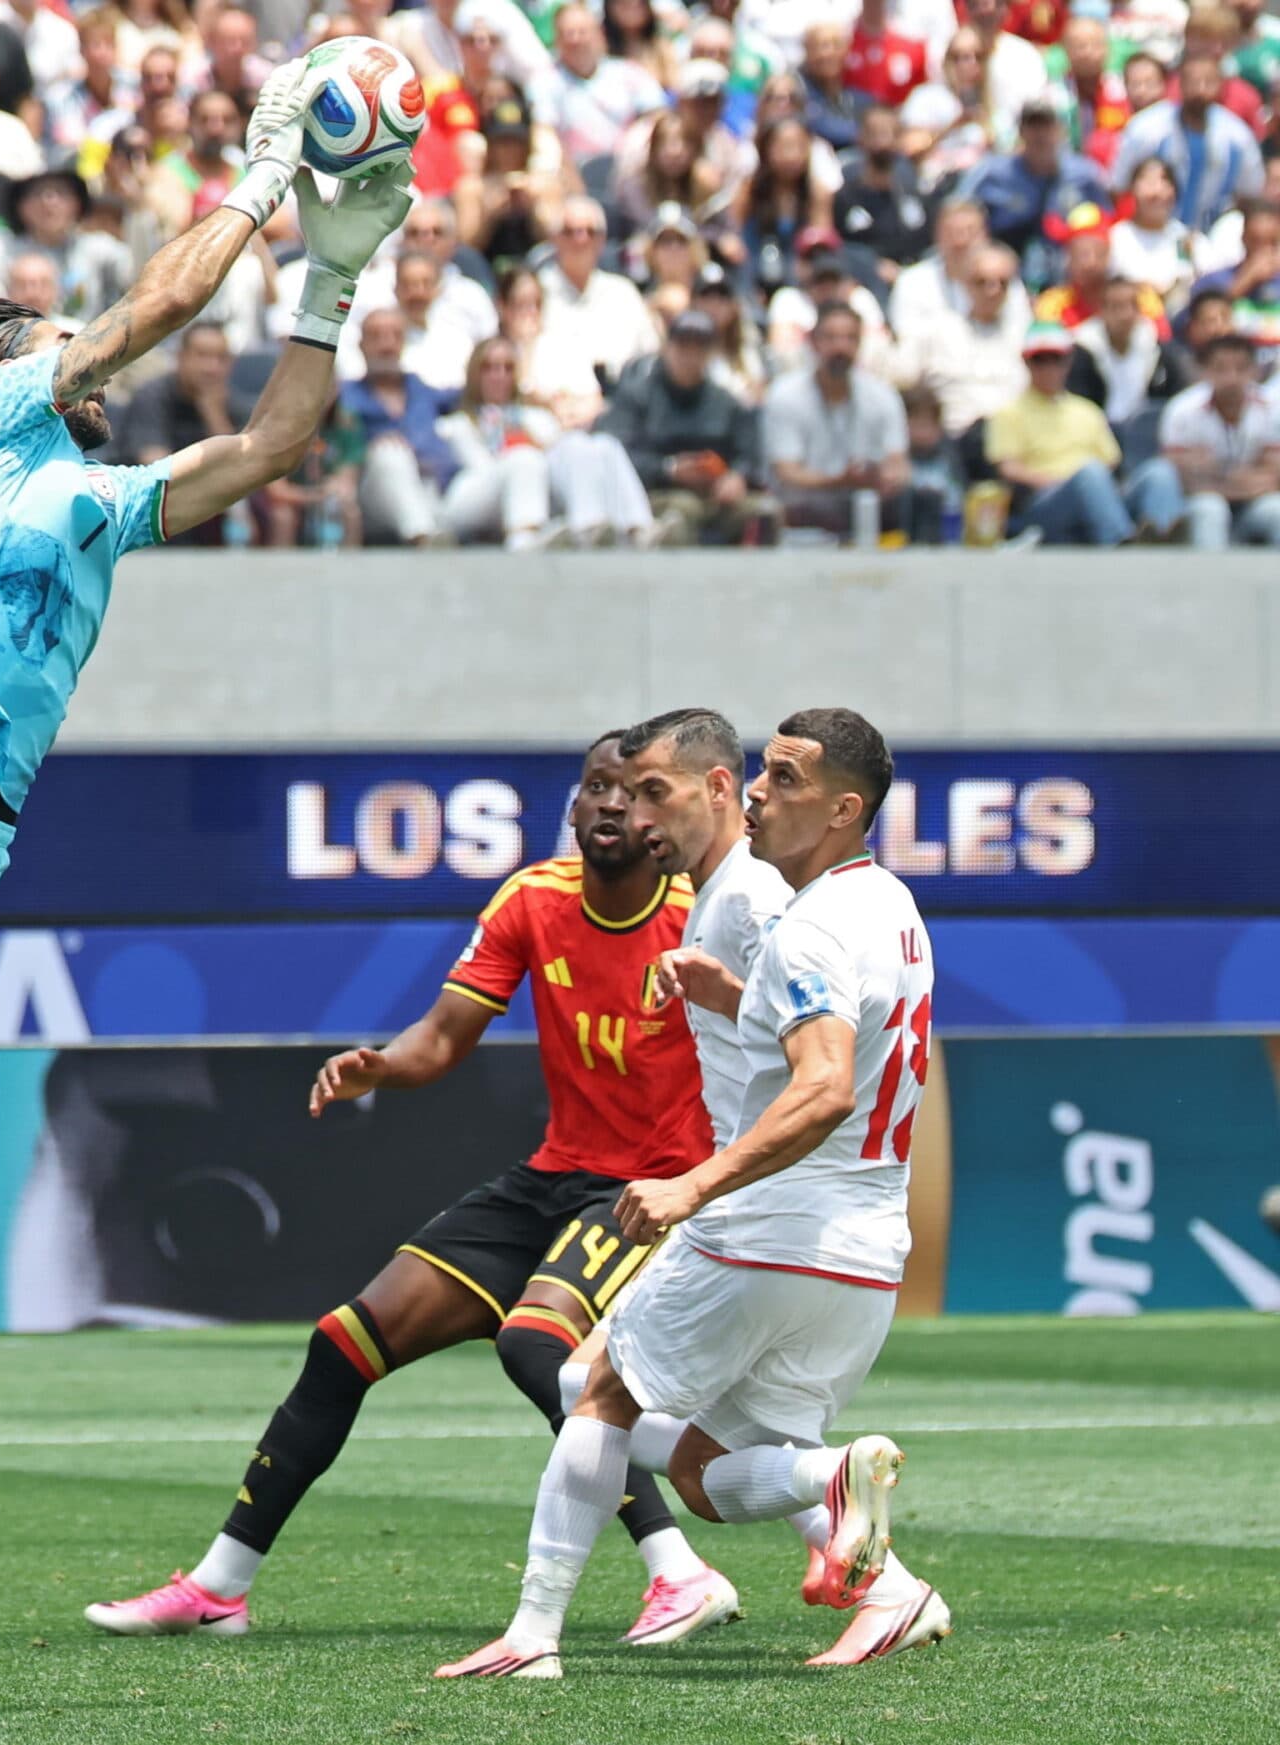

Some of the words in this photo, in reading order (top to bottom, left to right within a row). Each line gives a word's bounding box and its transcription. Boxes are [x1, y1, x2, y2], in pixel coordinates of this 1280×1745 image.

[286, 778, 523, 880] LOS
[575, 1010, 626, 1076] 14
[545, 1219, 621, 1280] 14
